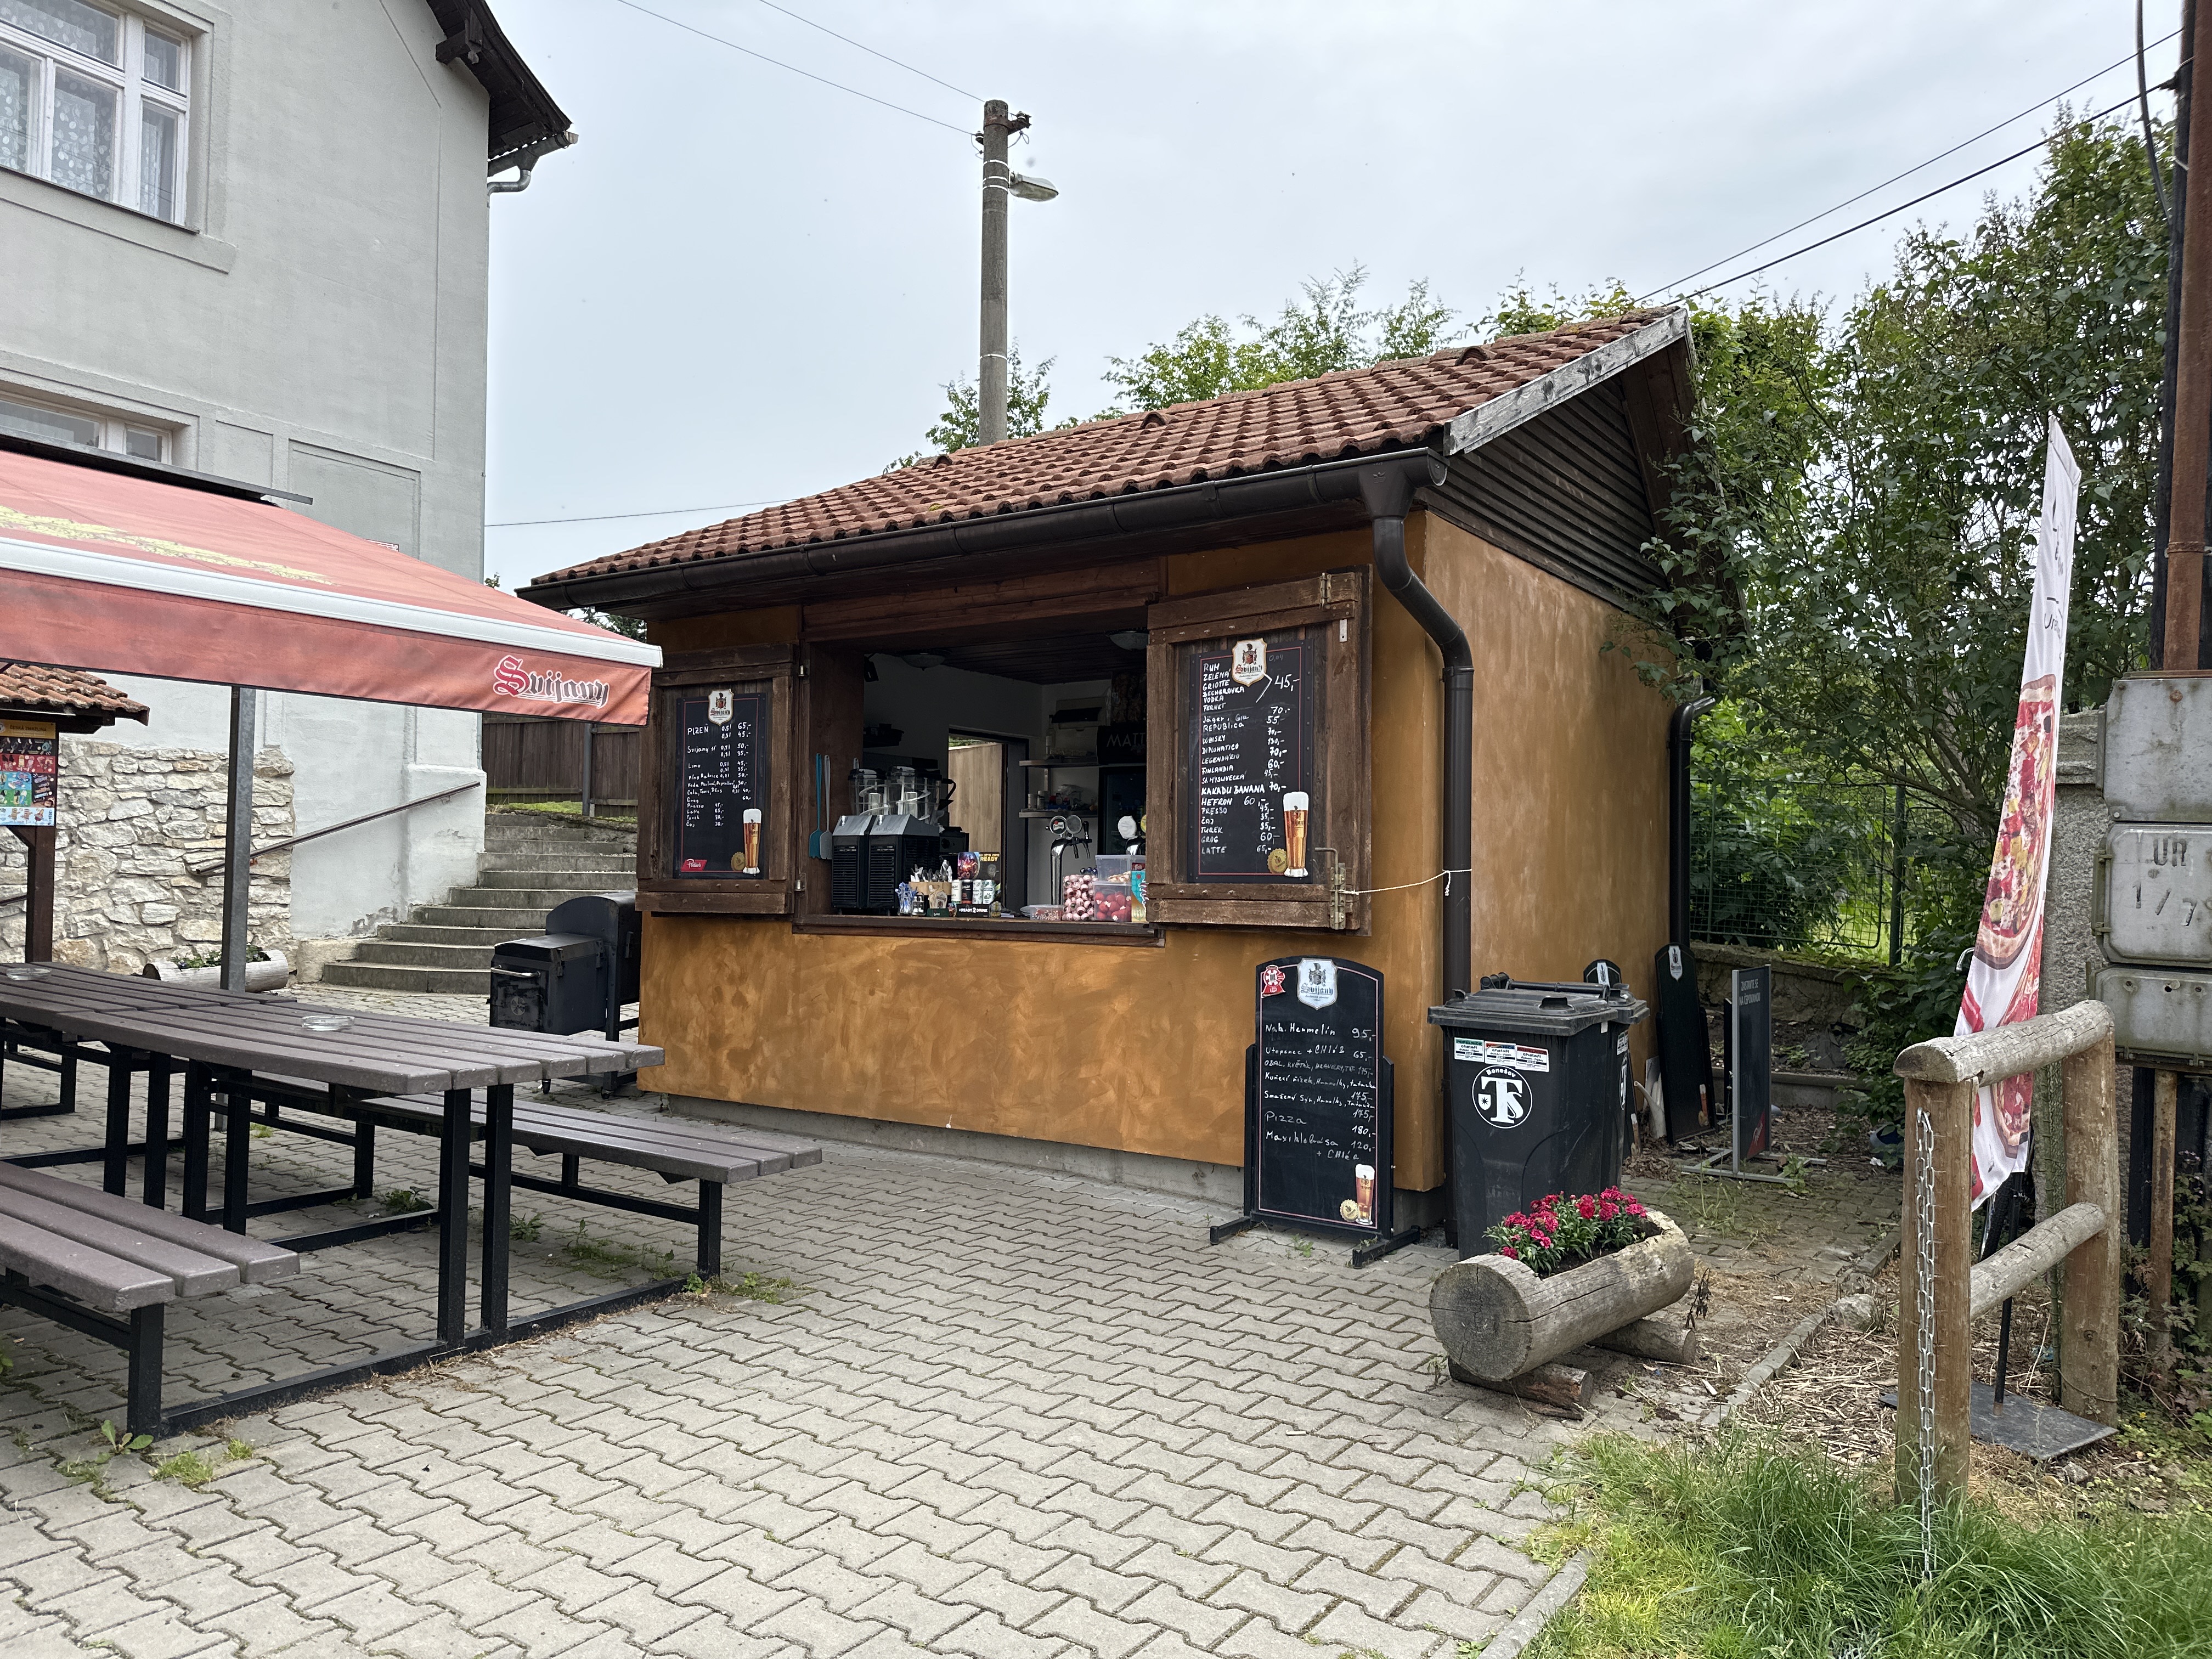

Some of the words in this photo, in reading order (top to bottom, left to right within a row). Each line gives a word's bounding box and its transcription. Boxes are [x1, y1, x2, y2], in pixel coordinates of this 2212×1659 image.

[1204, 663, 1220, 672] RUM
[493, 655, 609, 708] Svijany
[1203, 679, 1230, 691] GRIOTTE
[1204, 668, 1231, 681] ZELENÁ
[1274, 674, 1300, 691] 45,-
[1204, 695, 1224, 703] VODKA
[1203, 702, 1226, 712] FERNET
[687, 723, 709, 735] PLZEŇ
[737, 721, 751, 730] 65,-
[1107, 733, 1146, 748] MATT
[1203, 735, 1226, 744] WHISKY
[1202, 743, 1239, 754] DIPLOMATICO
[1269, 747, 1287, 757] 70,-
[1201, 765, 1234, 775] FINLANDIA
[1267, 759, 1284, 769] 60,-
[1201, 786, 1232, 795] KAKADU
[1234, 784, 1265, 794] BANANA
[1269, 782, 1286, 792] 70,-
[1201, 798, 1233, 806] HEFRON
[1201, 816, 1214, 825] ČAJ
[1201, 846, 1227, 855] LATTE
[1301, 983, 1333, 996] Svijany
[1486, 1068, 1516, 1077] Benešov
[1265, 1111, 1307, 1124] Pizza
